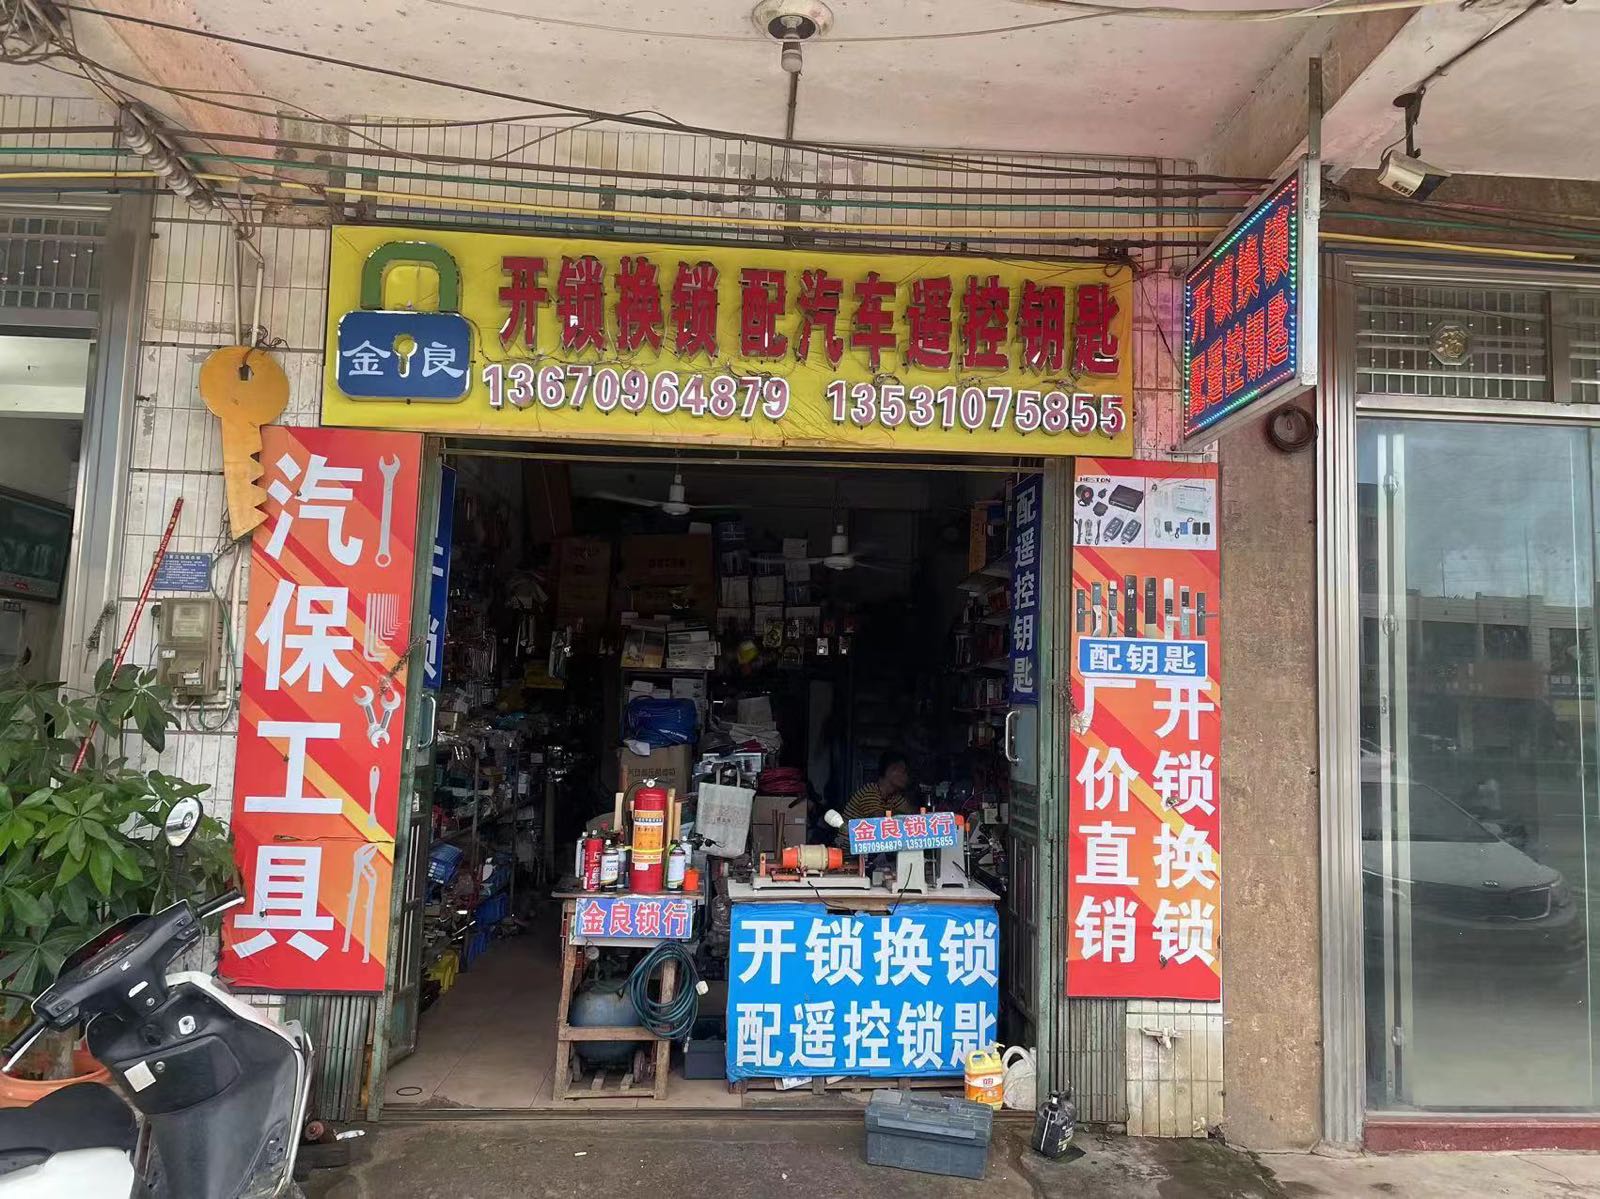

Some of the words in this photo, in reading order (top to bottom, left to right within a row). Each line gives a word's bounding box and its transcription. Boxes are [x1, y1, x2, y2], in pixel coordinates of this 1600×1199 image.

[1190, 204, 1290, 346] 开锁换锁
[482, 363, 791, 424] 13670964879
[826, 378, 1126, 436] 13531075855
[1012, 485, 1036, 695] 配遥控钥匙
[1089, 642, 1197, 675] 配钥匙
[231, 451, 365, 962] 汽保工具
[853, 813, 953, 841] 金良锁行
[854, 840, 902, 853] 13670964879
[905, 836, 954, 850] 13531075855
[1073, 679, 1140, 964] 厂价直销
[1153, 679, 1217, 966] 开锁换锁
[581, 901, 689, 937] 金良锁行
[738, 917, 999, 987] 开锁换锁
[736, 1000, 997, 1070] 配遥控锁匙
